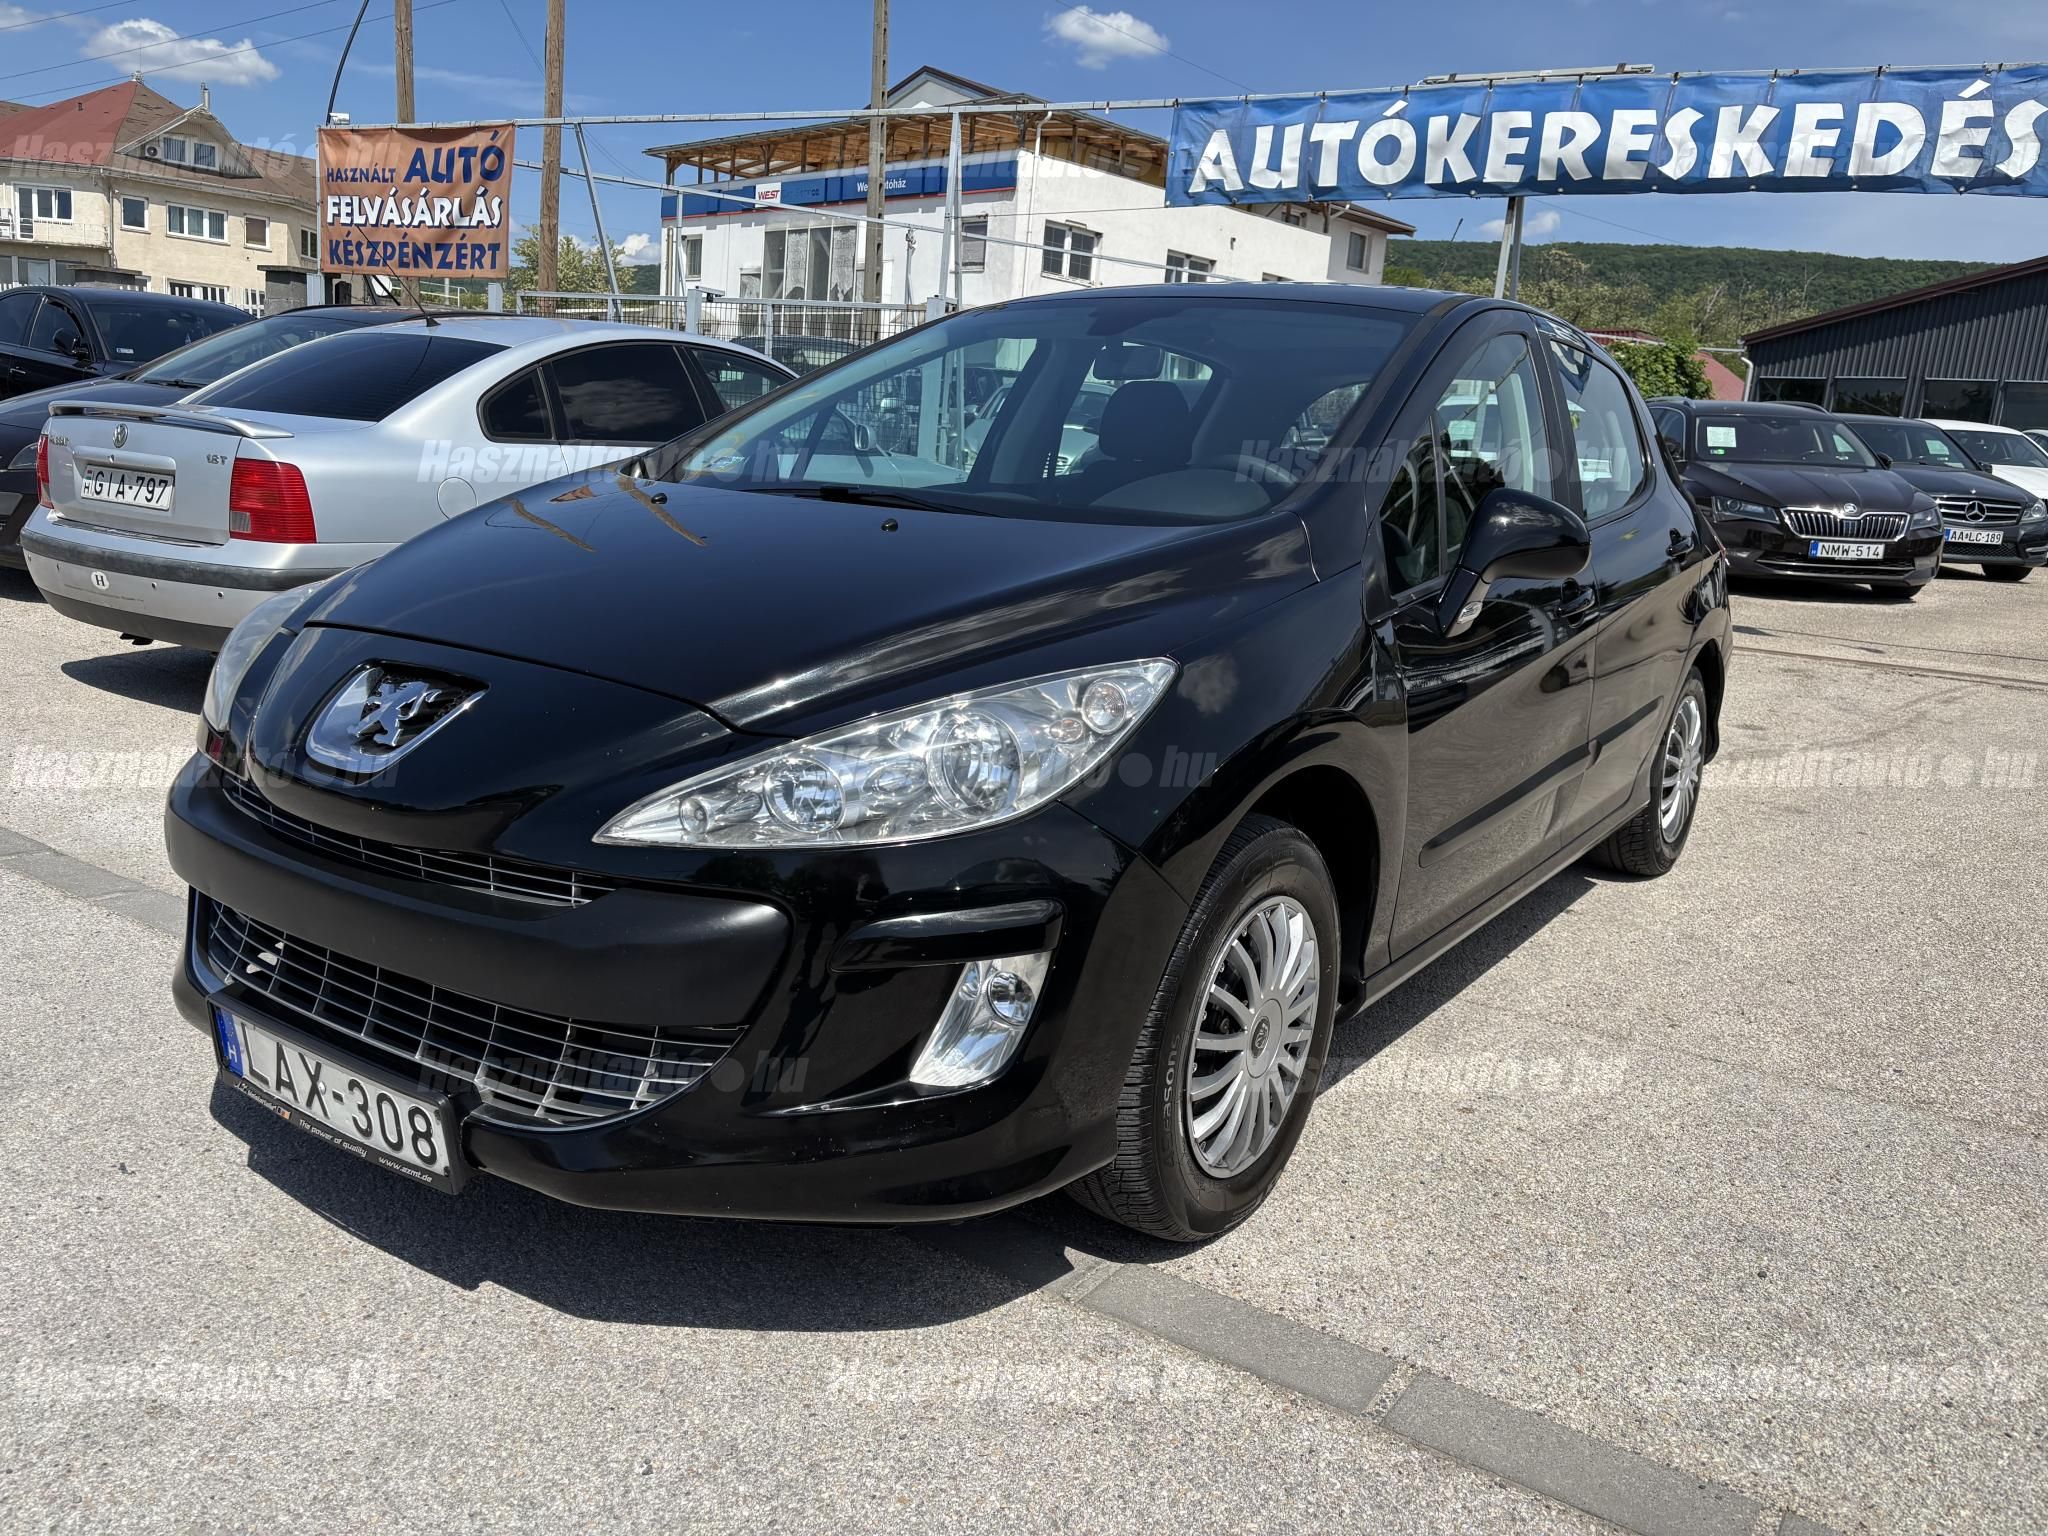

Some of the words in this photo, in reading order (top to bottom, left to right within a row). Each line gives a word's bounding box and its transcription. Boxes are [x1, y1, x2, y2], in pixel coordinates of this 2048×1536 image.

[1188, 79, 2048, 193] AUTÓKERESKEDÉS
[327, 163, 396, 184] HASZNÁLT
[403, 130, 505, 183] AUTÓ
[327, 185, 504, 229] FELVÁSÁRLÁS
[758, 190, 780, 200] WEST
[329, 231, 501, 270] KÉSZPÉNZÉRT
[94, 470, 168, 504] GIA-797
[1820, 544, 1880, 558] NMW-514
[95, 574, 106, 587] H
[241, 1021, 438, 1168] LAX-308
